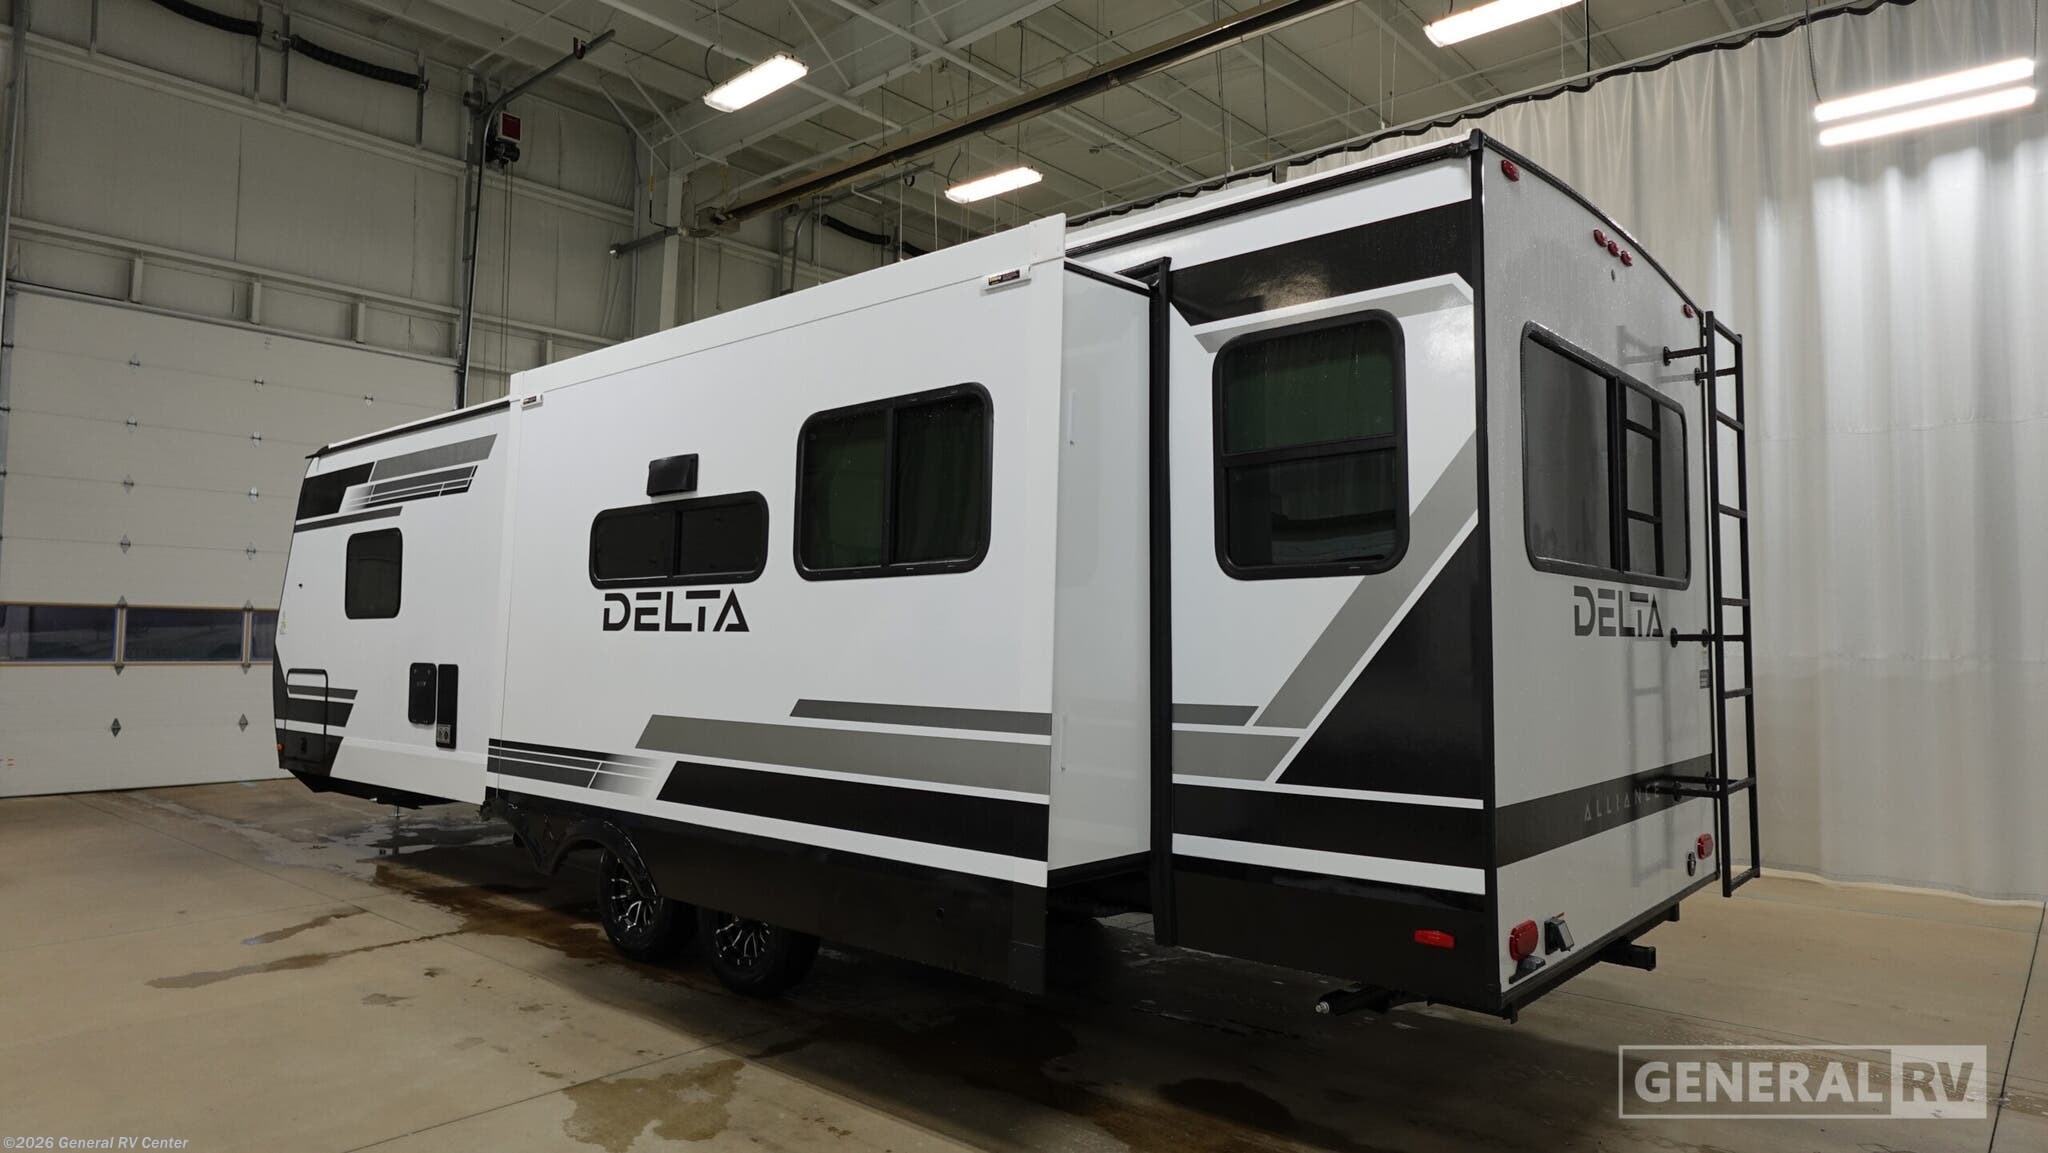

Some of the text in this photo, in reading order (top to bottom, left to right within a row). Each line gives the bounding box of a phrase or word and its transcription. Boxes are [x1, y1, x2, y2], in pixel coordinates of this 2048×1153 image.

[603, 588, 750, 632] DELTA
[1573, 585, 1664, 637] DELTA
[1584, 782, 1660, 821] ALLIANCE
